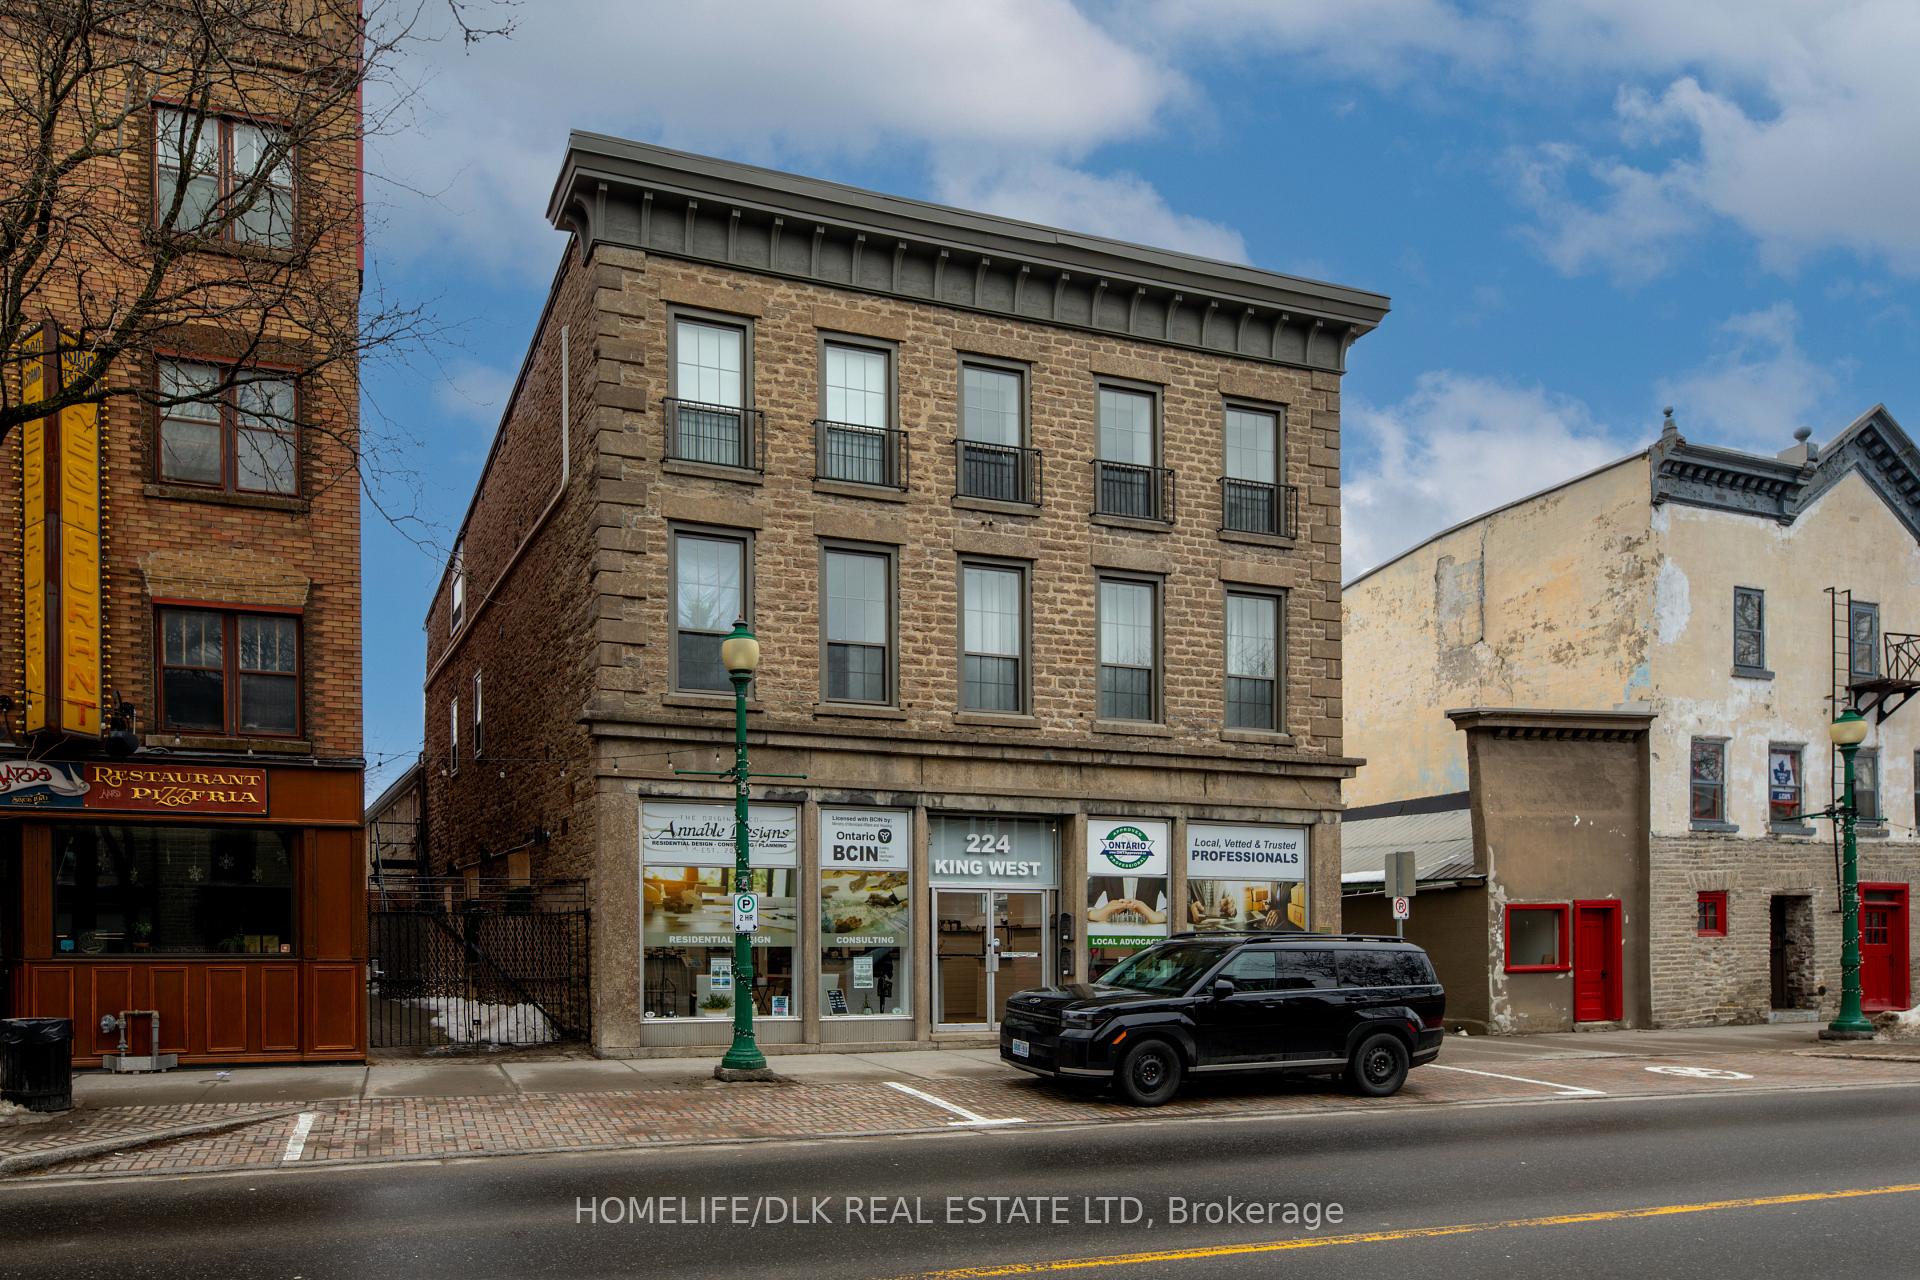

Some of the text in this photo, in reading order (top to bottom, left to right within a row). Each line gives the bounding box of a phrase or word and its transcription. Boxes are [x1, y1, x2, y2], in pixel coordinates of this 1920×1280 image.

[93, 767, 261, 788] RESTAURANT
[131, 786, 259, 807] PIZZERIA
[649, 820, 725, 840] Annable
[836, 831, 876, 841] Ontario
[965, 833, 1011, 854] 224
[1108, 841, 1147, 850] ONTARIO
[1194, 838, 1297, 850] Local, Vetted & Trusted
[833, 845, 879, 862] BCIN
[1191, 850, 1299, 864] PROFESSIONALS
[935, 859, 1041, 876] KING WEST
[742, 899, 751, 909] P
[745, 914, 754, 922] HR
[669, 935, 733, 945] RESIDENTIAL
[836, 935, 895, 945] CONSULTING
